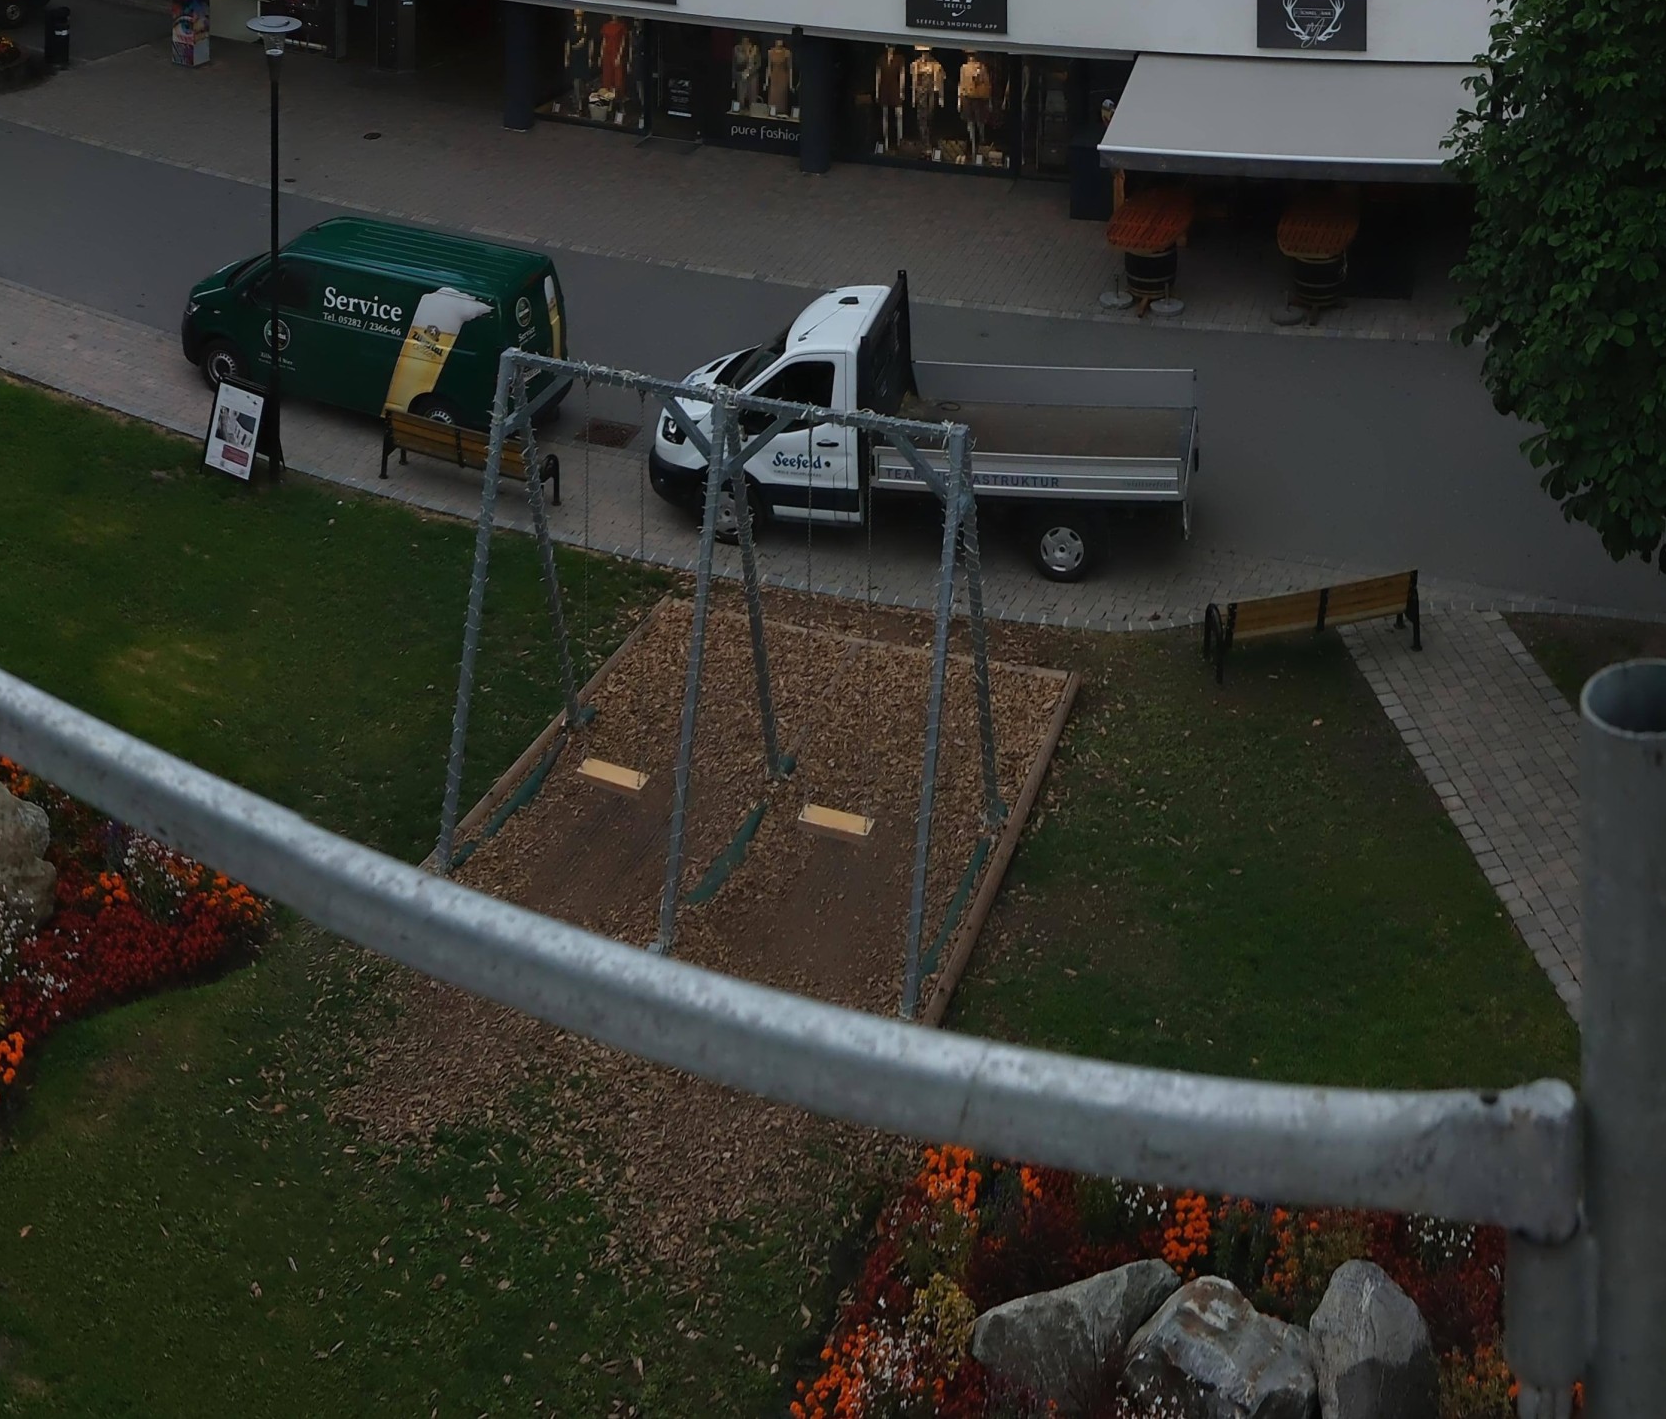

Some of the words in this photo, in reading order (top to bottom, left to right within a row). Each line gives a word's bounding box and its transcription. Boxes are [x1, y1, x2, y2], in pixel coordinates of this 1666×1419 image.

[916, 18, 946, 26] SEEFELD
[730, 124, 757, 138] pure
[322, 286, 403, 321] Service
[322, 311, 337, 324] Tel.
[339, 315, 361, 328] 05282
[370, 321, 402, 337] 2366-66
